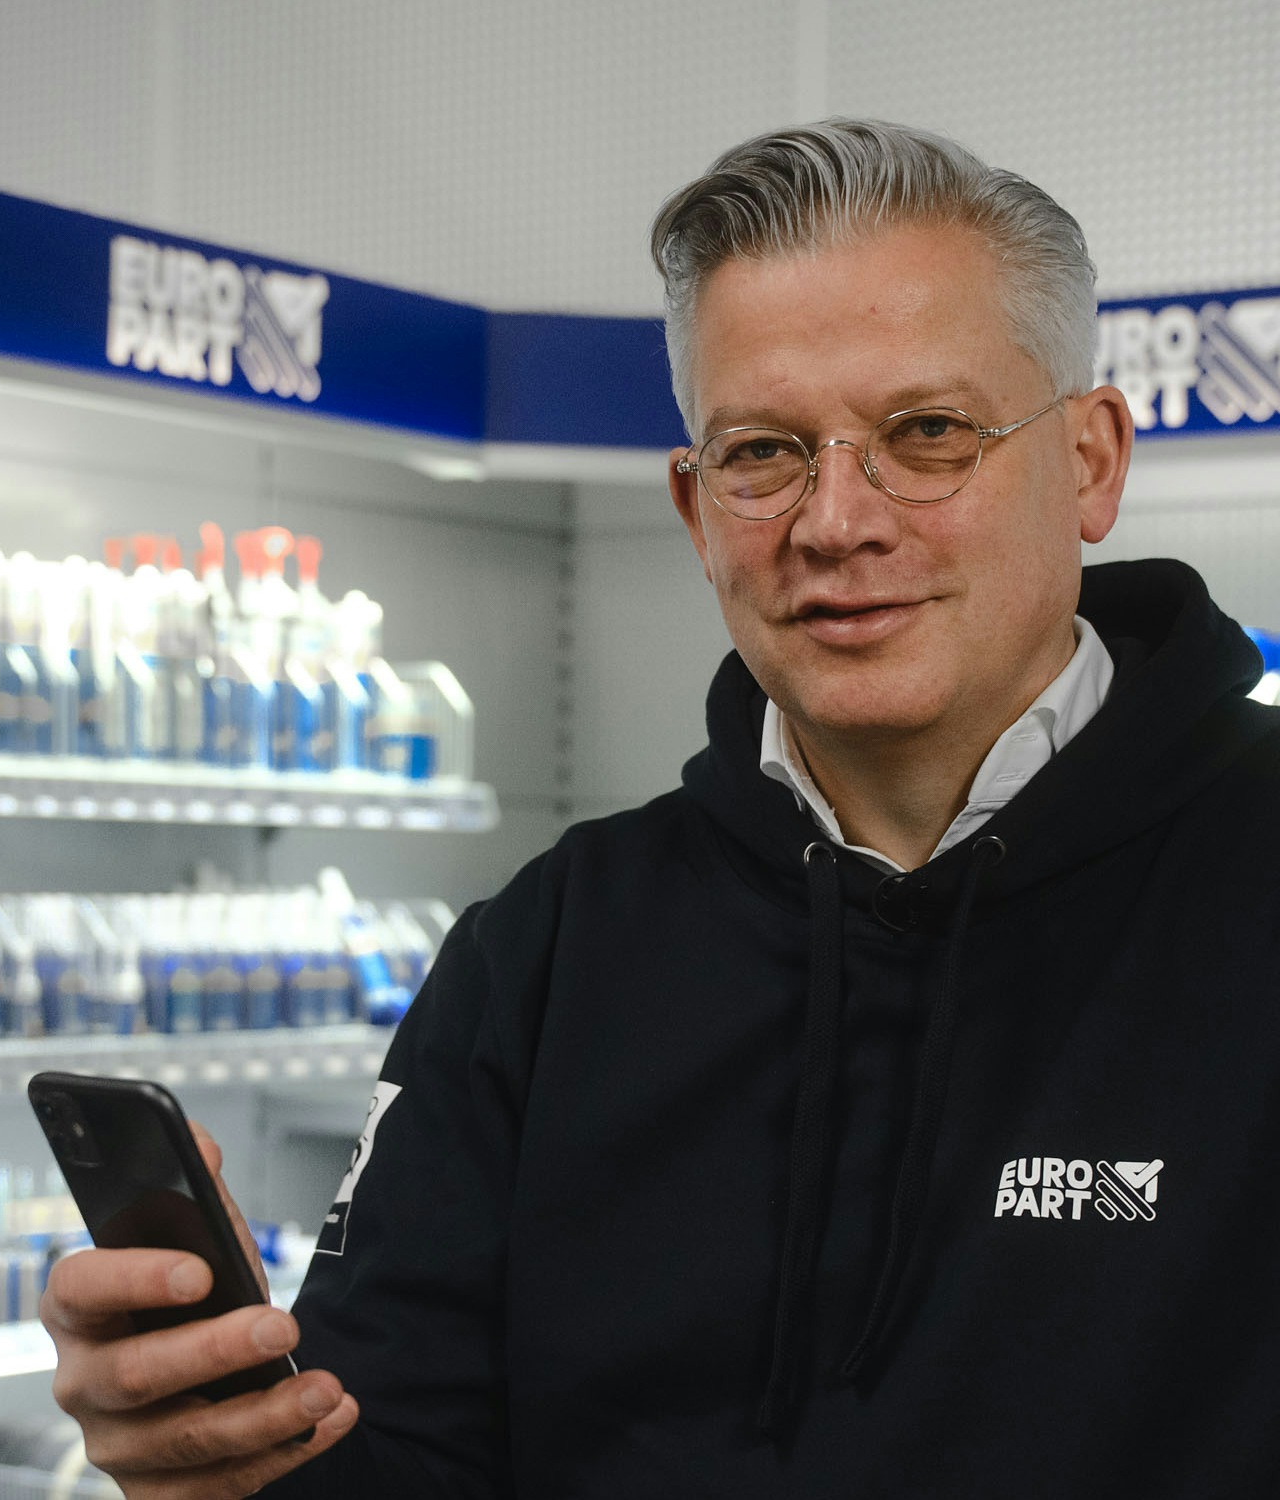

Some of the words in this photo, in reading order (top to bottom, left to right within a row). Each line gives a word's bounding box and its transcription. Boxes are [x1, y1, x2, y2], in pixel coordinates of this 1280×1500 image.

[109, 235, 245, 326] EURO
[106, 301, 244, 386] PART
[1097, 304, 1200, 366] RO
[1095, 362, 1202, 430] RT
[994, 1187, 1092, 1221] PART
[998, 1157, 1093, 1190] EURO
